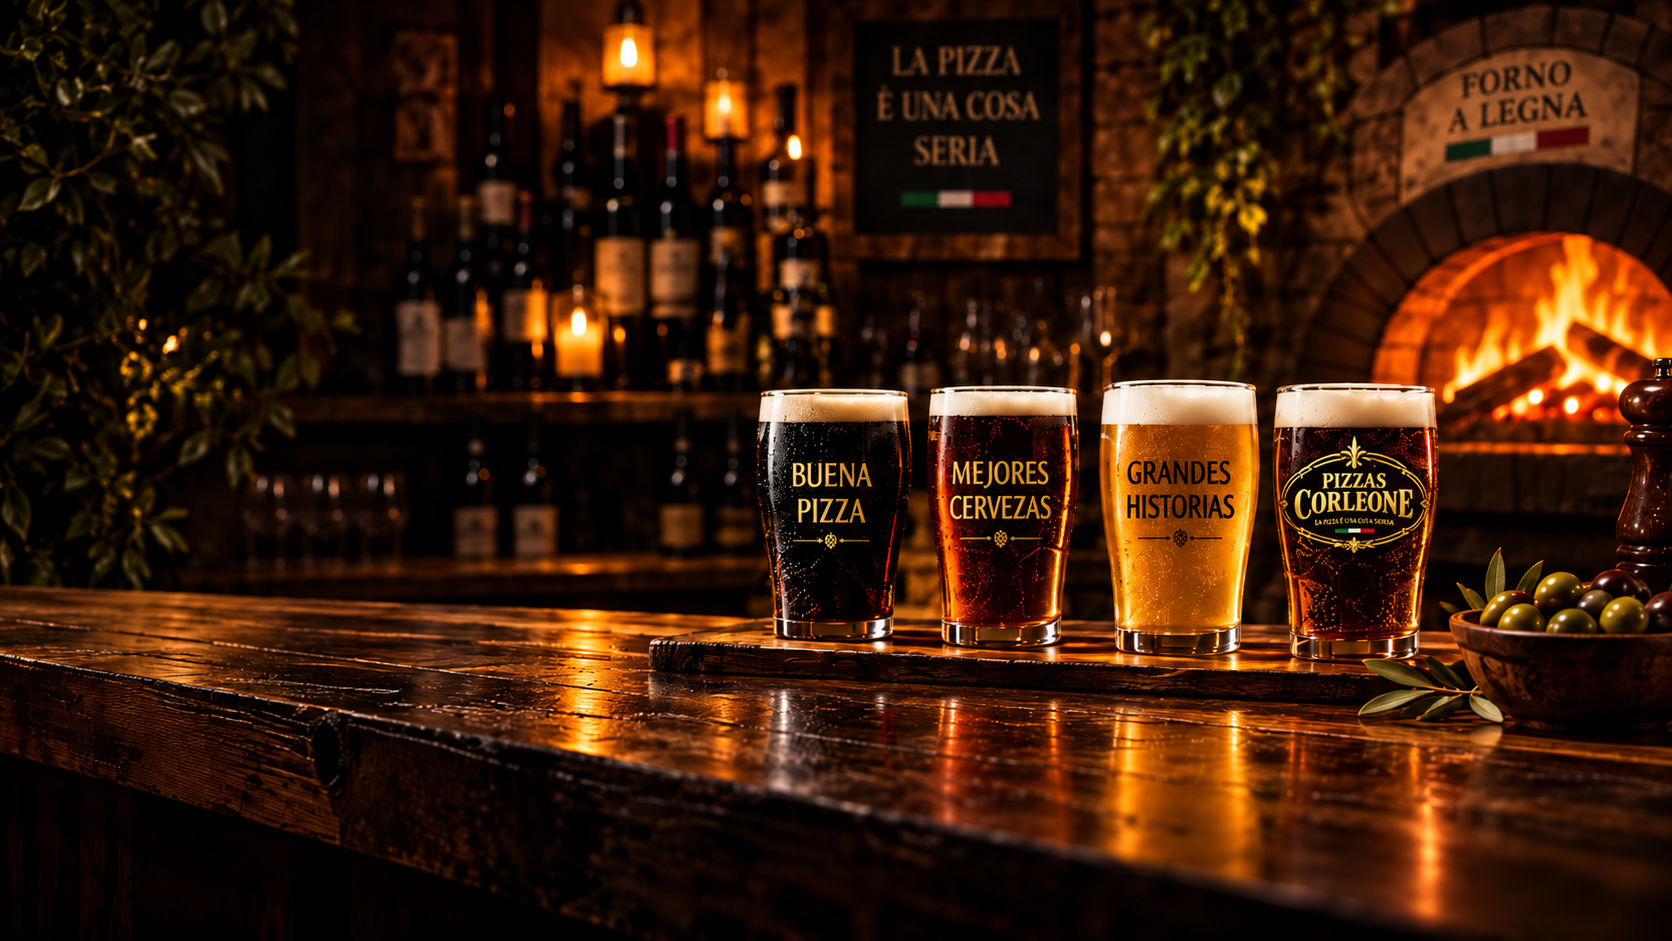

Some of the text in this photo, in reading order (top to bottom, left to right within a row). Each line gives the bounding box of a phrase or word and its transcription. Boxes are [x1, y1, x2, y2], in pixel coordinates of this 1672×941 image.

[892, 46, 1021, 76] LA PIZZA
[1462, 59, 1572, 98] FORNO
[902, 91, 960, 121] UNA
[965, 90, 1040, 121] COSA
[1448, 91, 1588, 133] A LEGNA
[914, 135, 999, 166] SERIA
[792, 462, 873, 488] BUENA
[952, 461, 1049, 489] MEJORES
[1127, 460, 1231, 485] GRANDES
[1322, 472, 1387, 489] PIZZAS
[797, 498, 866, 524] PIZZA
[949, 495, 1052, 520] CERVEZAS
[1126, 494, 1235, 519] HISTORIAS
[1294, 488, 1414, 520] CORLEONE
